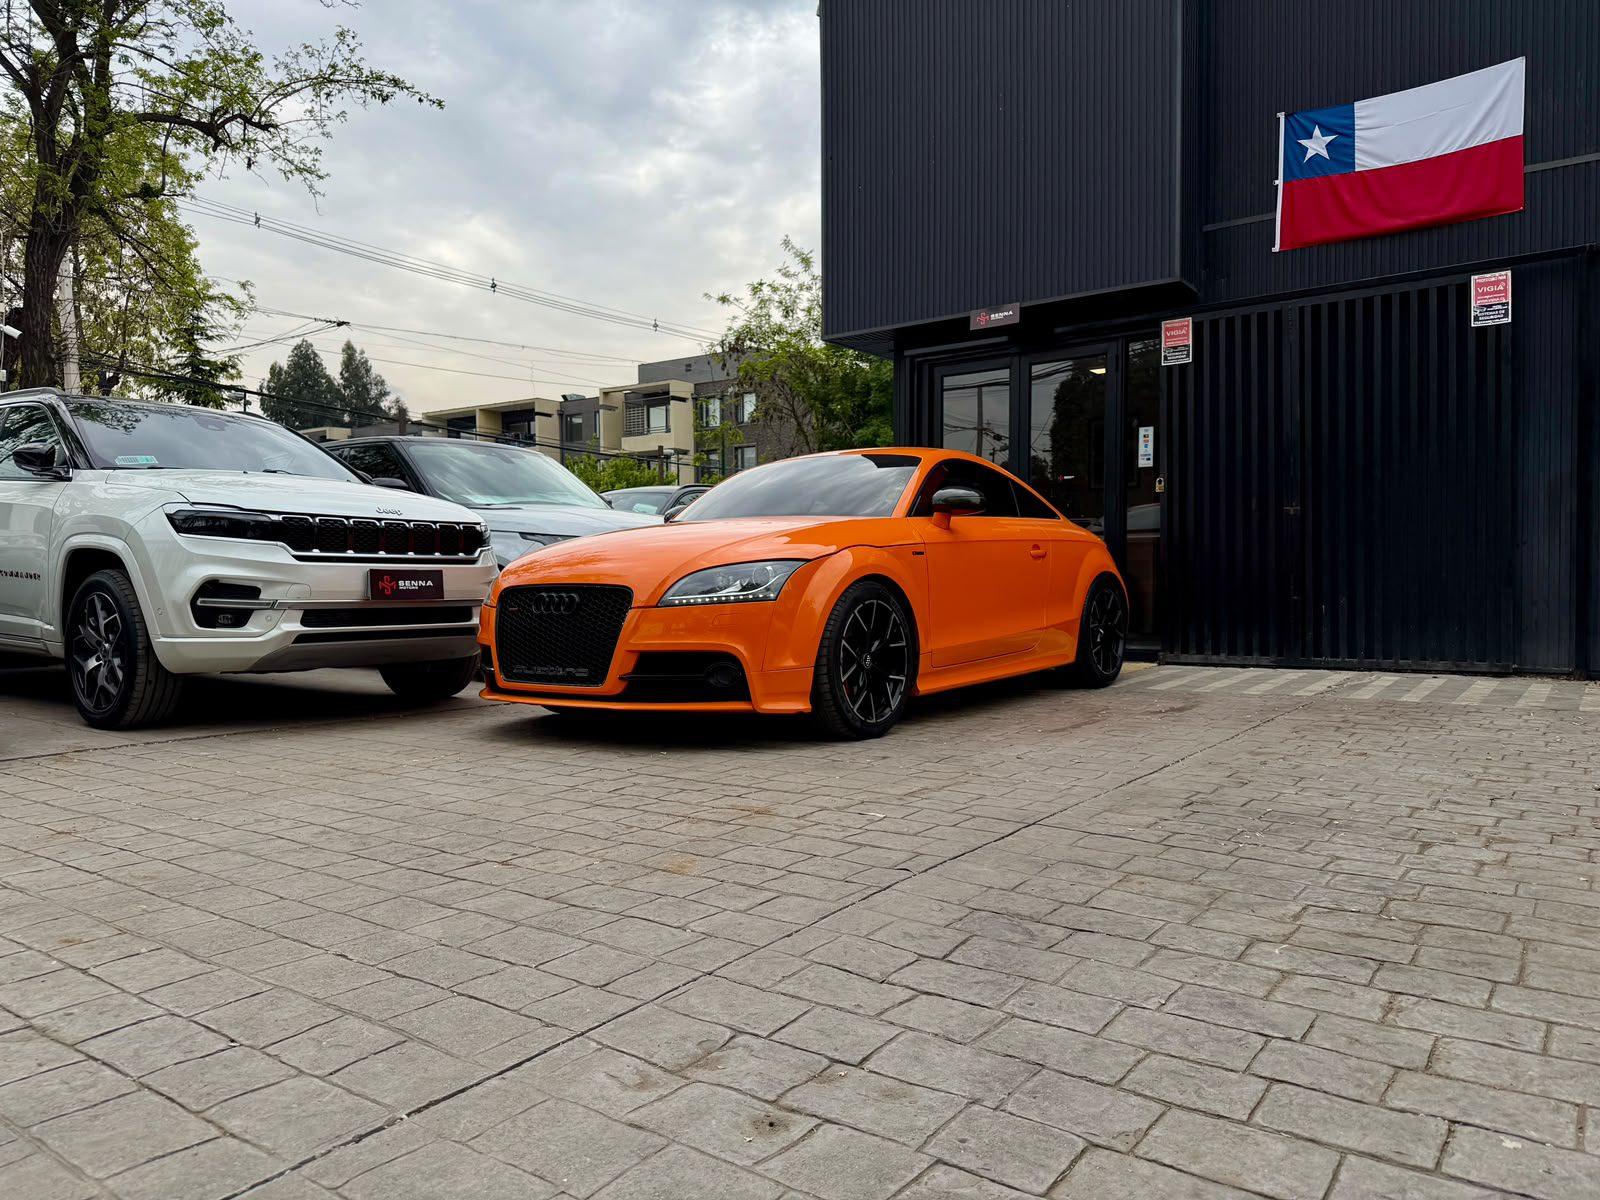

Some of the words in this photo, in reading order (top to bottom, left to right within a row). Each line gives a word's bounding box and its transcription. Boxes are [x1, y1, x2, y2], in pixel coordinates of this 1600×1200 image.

[1477, 284, 1504, 293] VIGIA
[990, 310, 1014, 318] SENNA
[375, 506, 403, 516] Jeep
